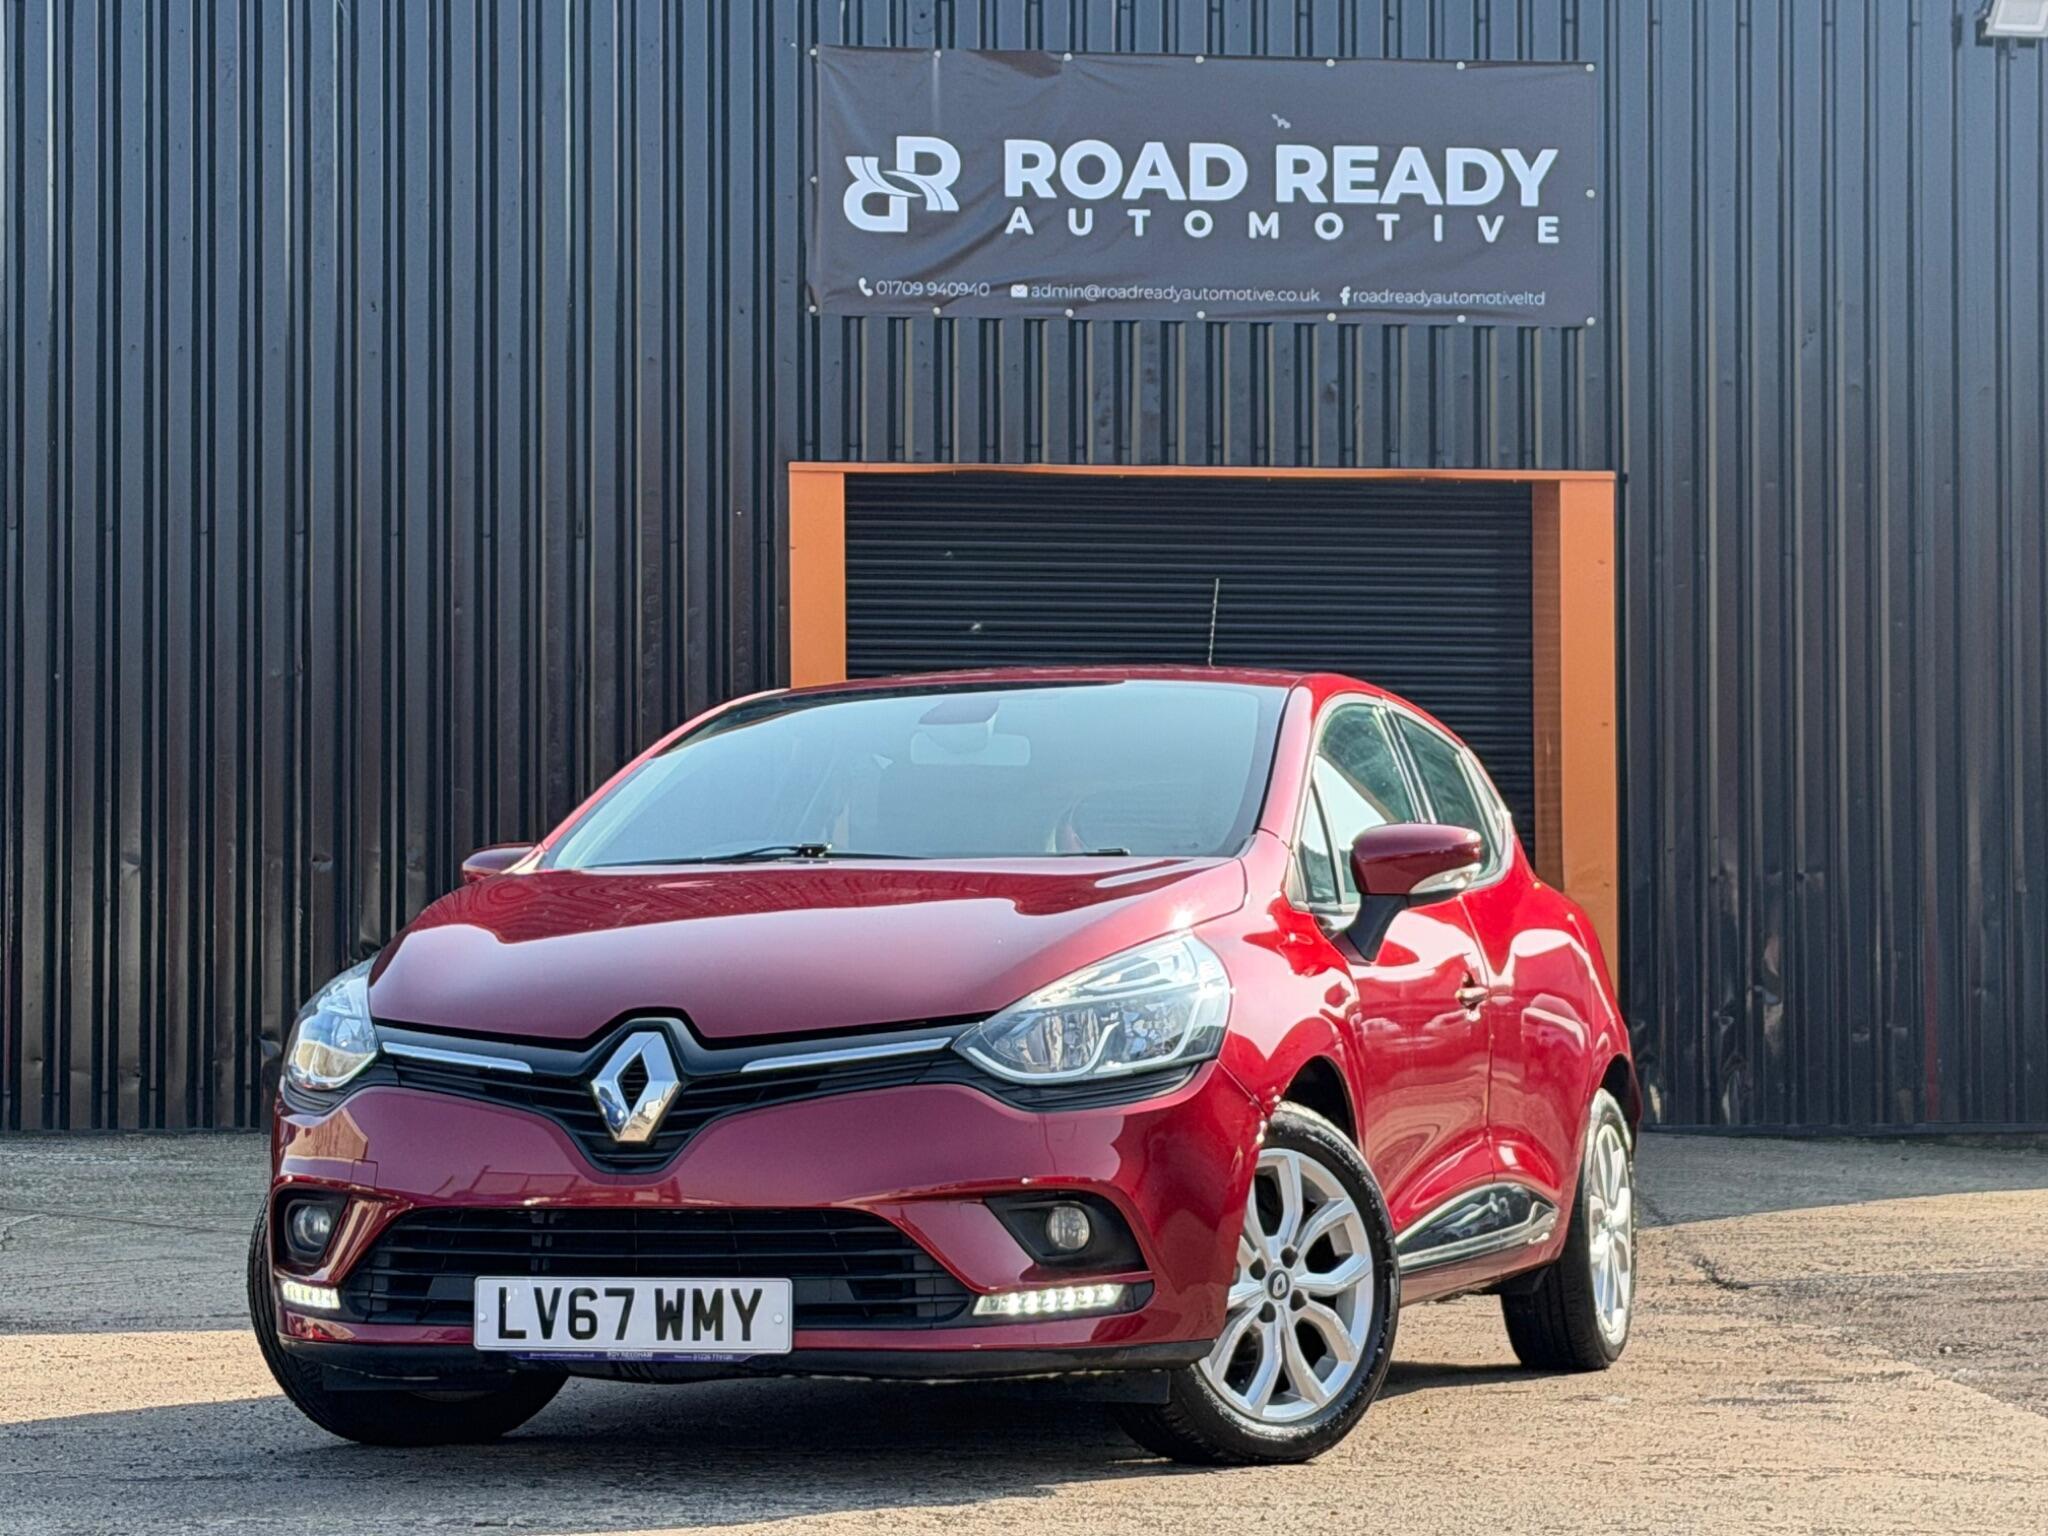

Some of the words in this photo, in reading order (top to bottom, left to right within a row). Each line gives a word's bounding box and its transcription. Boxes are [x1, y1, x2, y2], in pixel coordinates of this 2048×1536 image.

[1004, 139, 1249, 201] ROAD
[1275, 144, 1559, 207] READY
[1004, 206, 1559, 243] AUTOMOTIVE
[876, 281, 923, 296] 01709
[926, 281, 990, 297] 940940
[1031, 284, 1320, 303] admin@roadreadyautomotive.co.uk
[1353, 288, 1546, 307] roadreadyautomotiveltd
[497, 1286, 635, 1341] LV67
[654, 1287, 763, 1342] WMY
